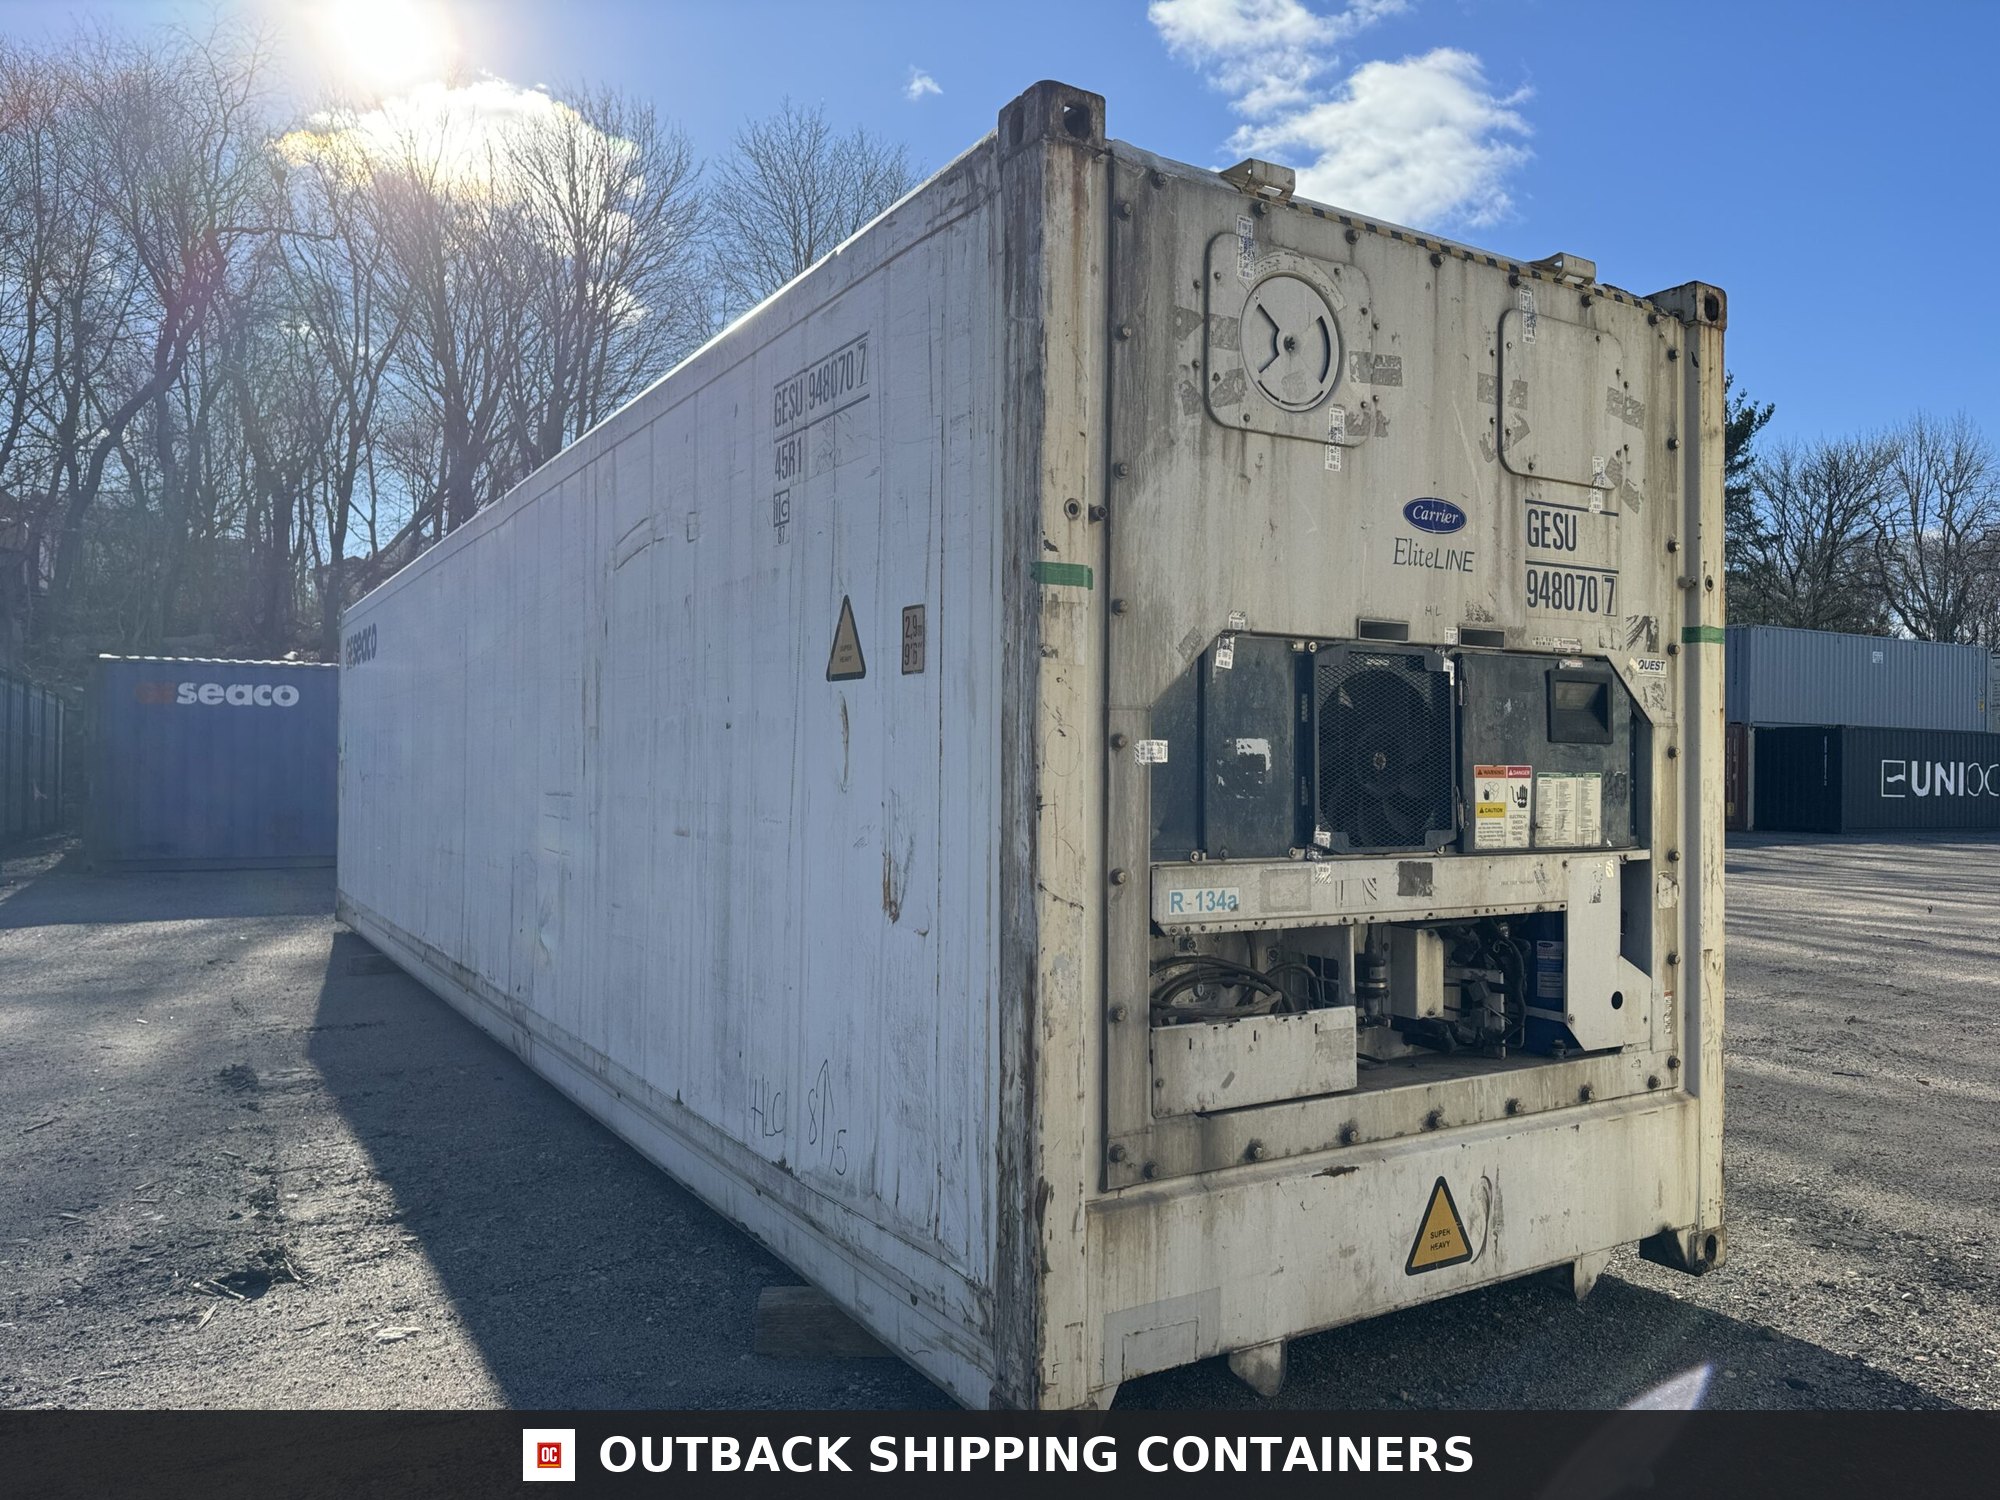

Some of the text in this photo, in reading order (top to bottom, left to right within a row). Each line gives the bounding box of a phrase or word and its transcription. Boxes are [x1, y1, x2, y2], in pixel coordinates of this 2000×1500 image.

[775, 341, 867, 428] GESU 948070 7
[775, 437, 802, 482] 45R1
[1412, 505, 1459, 525] Carrier
[1527, 508, 1578, 552] GESU
[1392, 537, 1475, 573] EliteLINE
[1526, 569, 1615, 615] 948070 7
[1638, 659, 1666, 672] QUEST
[176, 682, 300, 708] seaco
[1170, 889, 1238, 914] R-134a
[1430, 1229, 1451, 1240] SUPER
[1430, 1240, 1451, 1251] HEAVY
